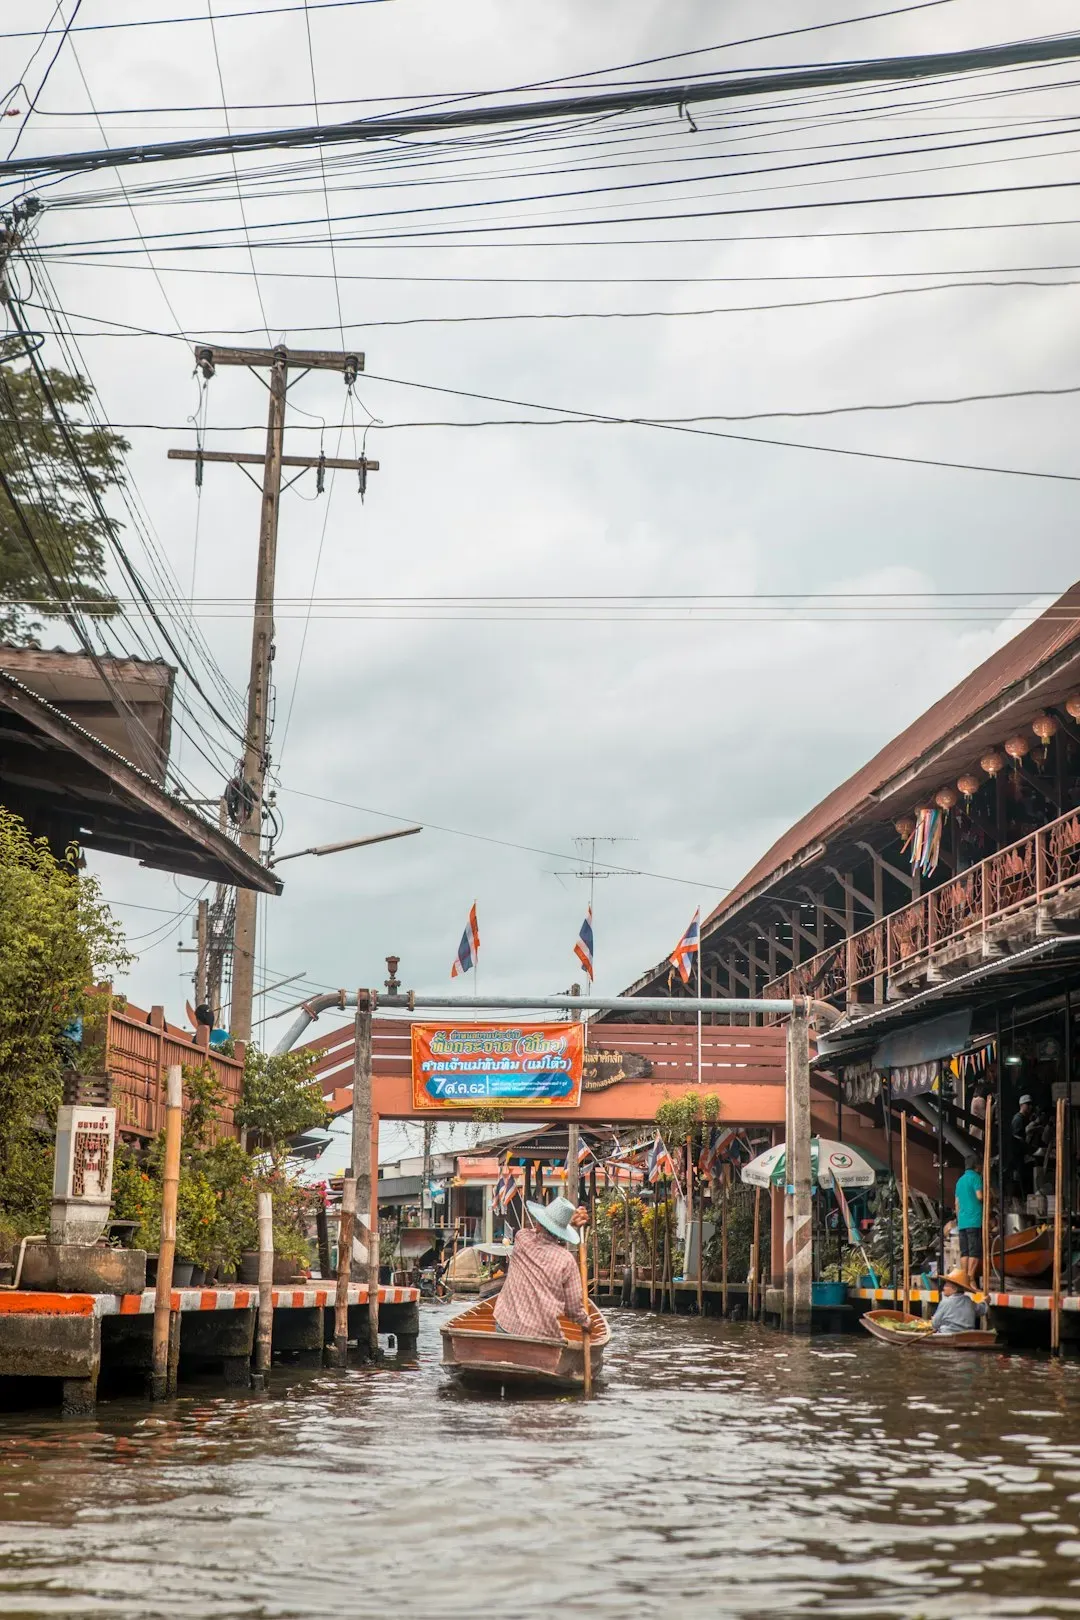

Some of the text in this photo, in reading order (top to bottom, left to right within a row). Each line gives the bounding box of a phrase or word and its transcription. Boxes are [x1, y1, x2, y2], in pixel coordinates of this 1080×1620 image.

[431, 1031, 513, 1053] ทิ้งกระจาด
[422, 1057, 520, 1071] ศาลเจ้าแม่ทับทิม
